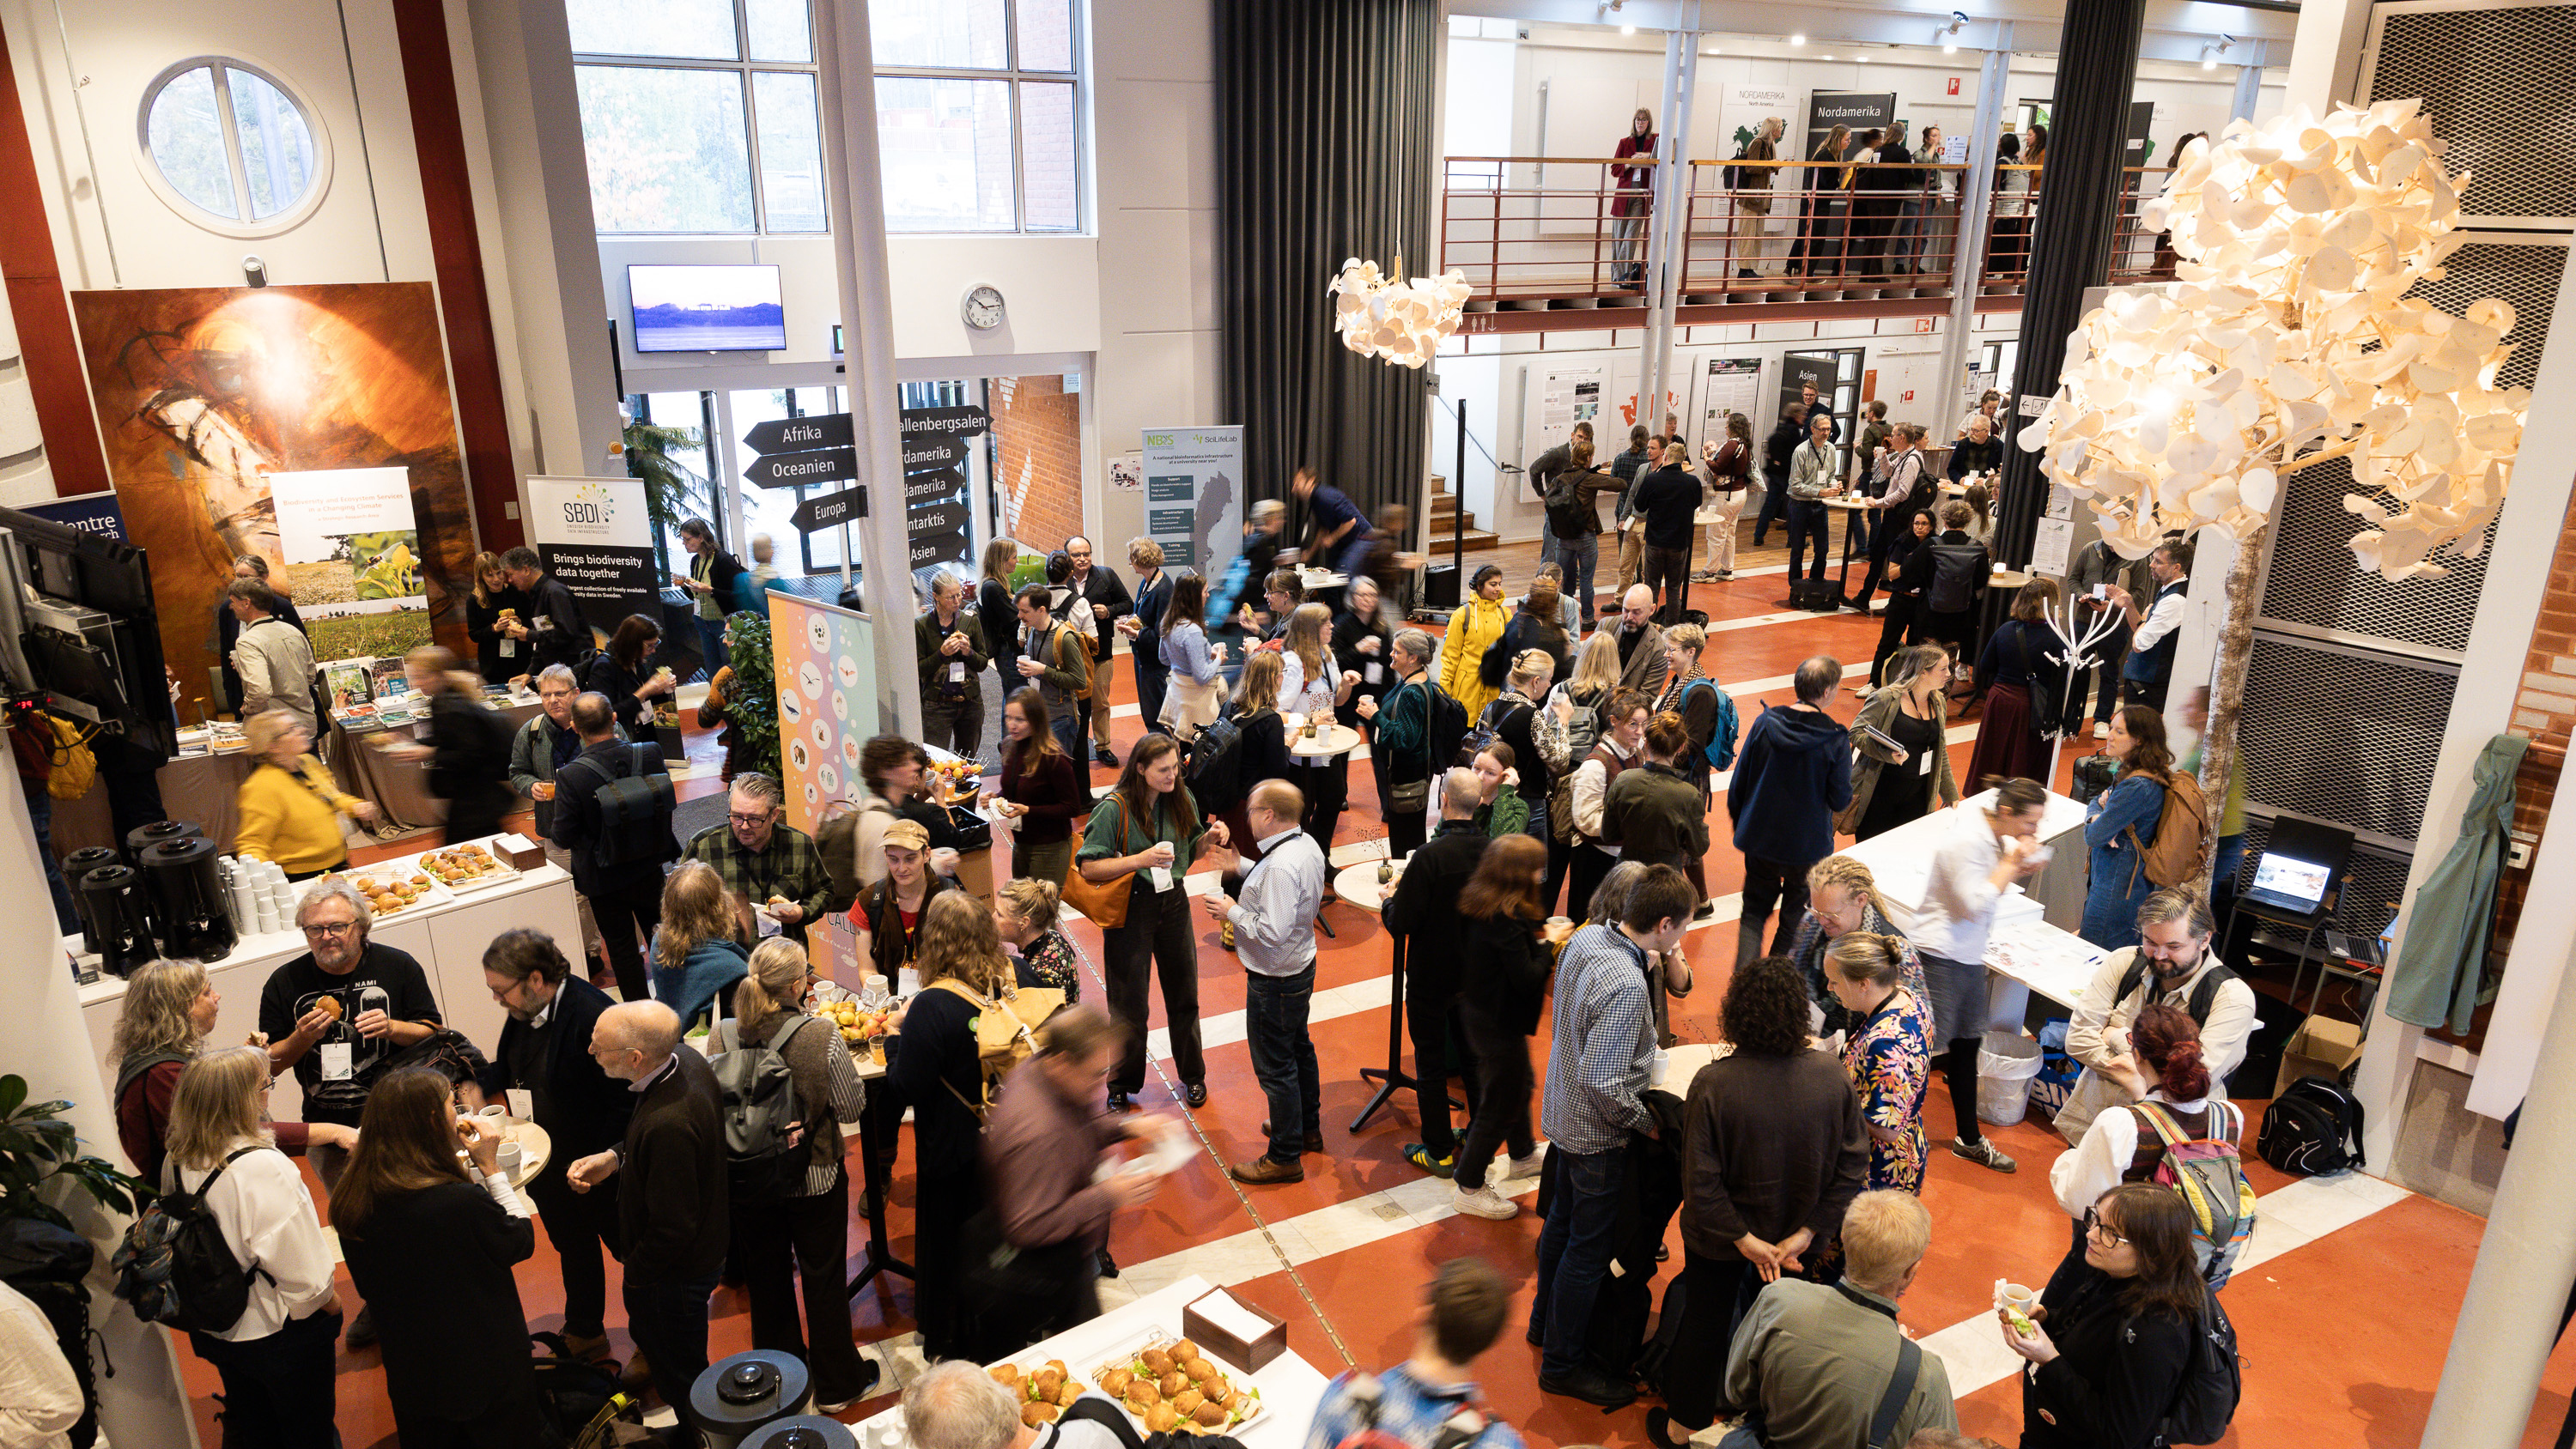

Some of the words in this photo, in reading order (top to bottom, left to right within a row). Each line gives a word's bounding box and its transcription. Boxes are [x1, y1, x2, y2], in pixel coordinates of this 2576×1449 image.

[1739, 90, 1785, 100] NORDAMERIKA
[1818, 106, 1880, 118] Nordamerika
[1798, 369, 1818, 382] Asien
[782, 426, 822, 443] Afrika
[902, 446, 951, 464] damerika
[772, 459, 835, 478] Oceanien
[283, 498, 324, 506] Biodiversity
[563, 502, 600, 524] SBDI
[815, 501, 847, 521] Europa
[908, 512, 945, 531] ntarktis
[553, 554, 585, 567] Brings
[586, 555, 642, 568] biodiversity
[910, 545, 936, 562] Asien
[556, 567, 578, 577] data
[579, 568, 620, 579] together
[355, 979, 377, 988] NAMI
